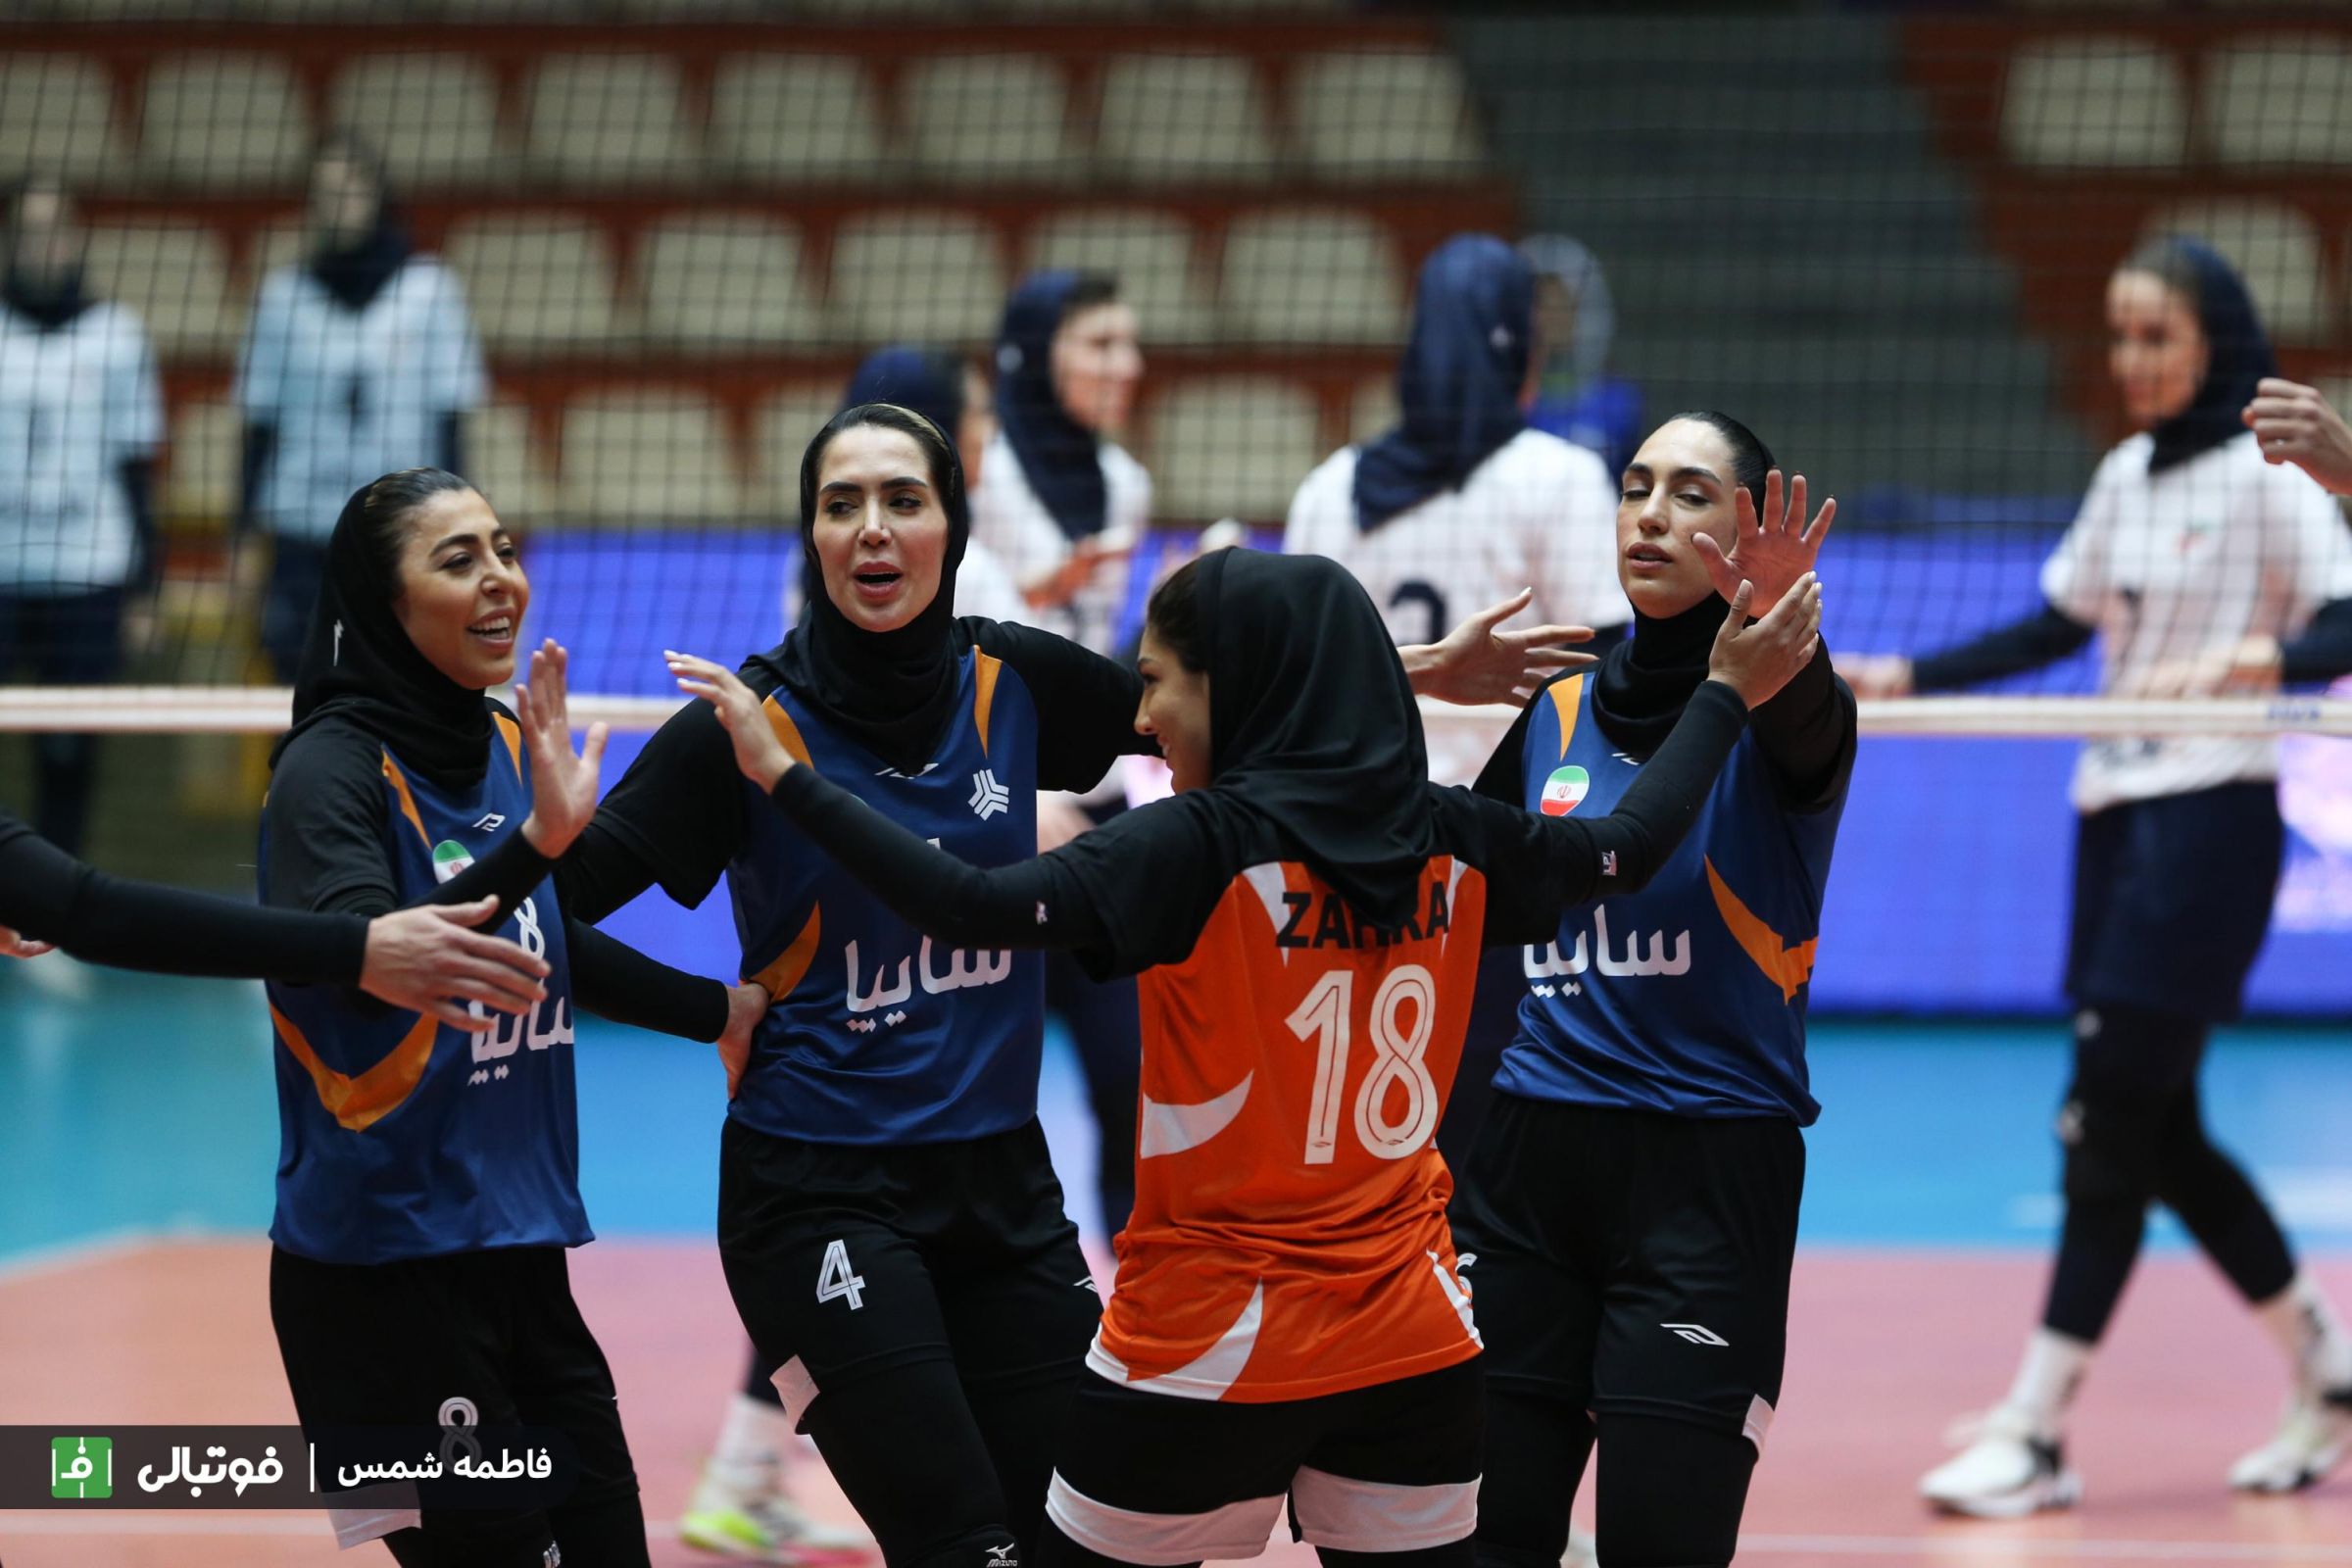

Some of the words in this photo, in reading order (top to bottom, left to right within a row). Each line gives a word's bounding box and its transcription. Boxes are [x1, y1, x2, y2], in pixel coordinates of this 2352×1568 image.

[514, 897, 546, 960] 8
[1285, 964, 1439, 1164] 18
[815, 1239, 866, 1310] 4
[437, 1396, 483, 1474] 8
